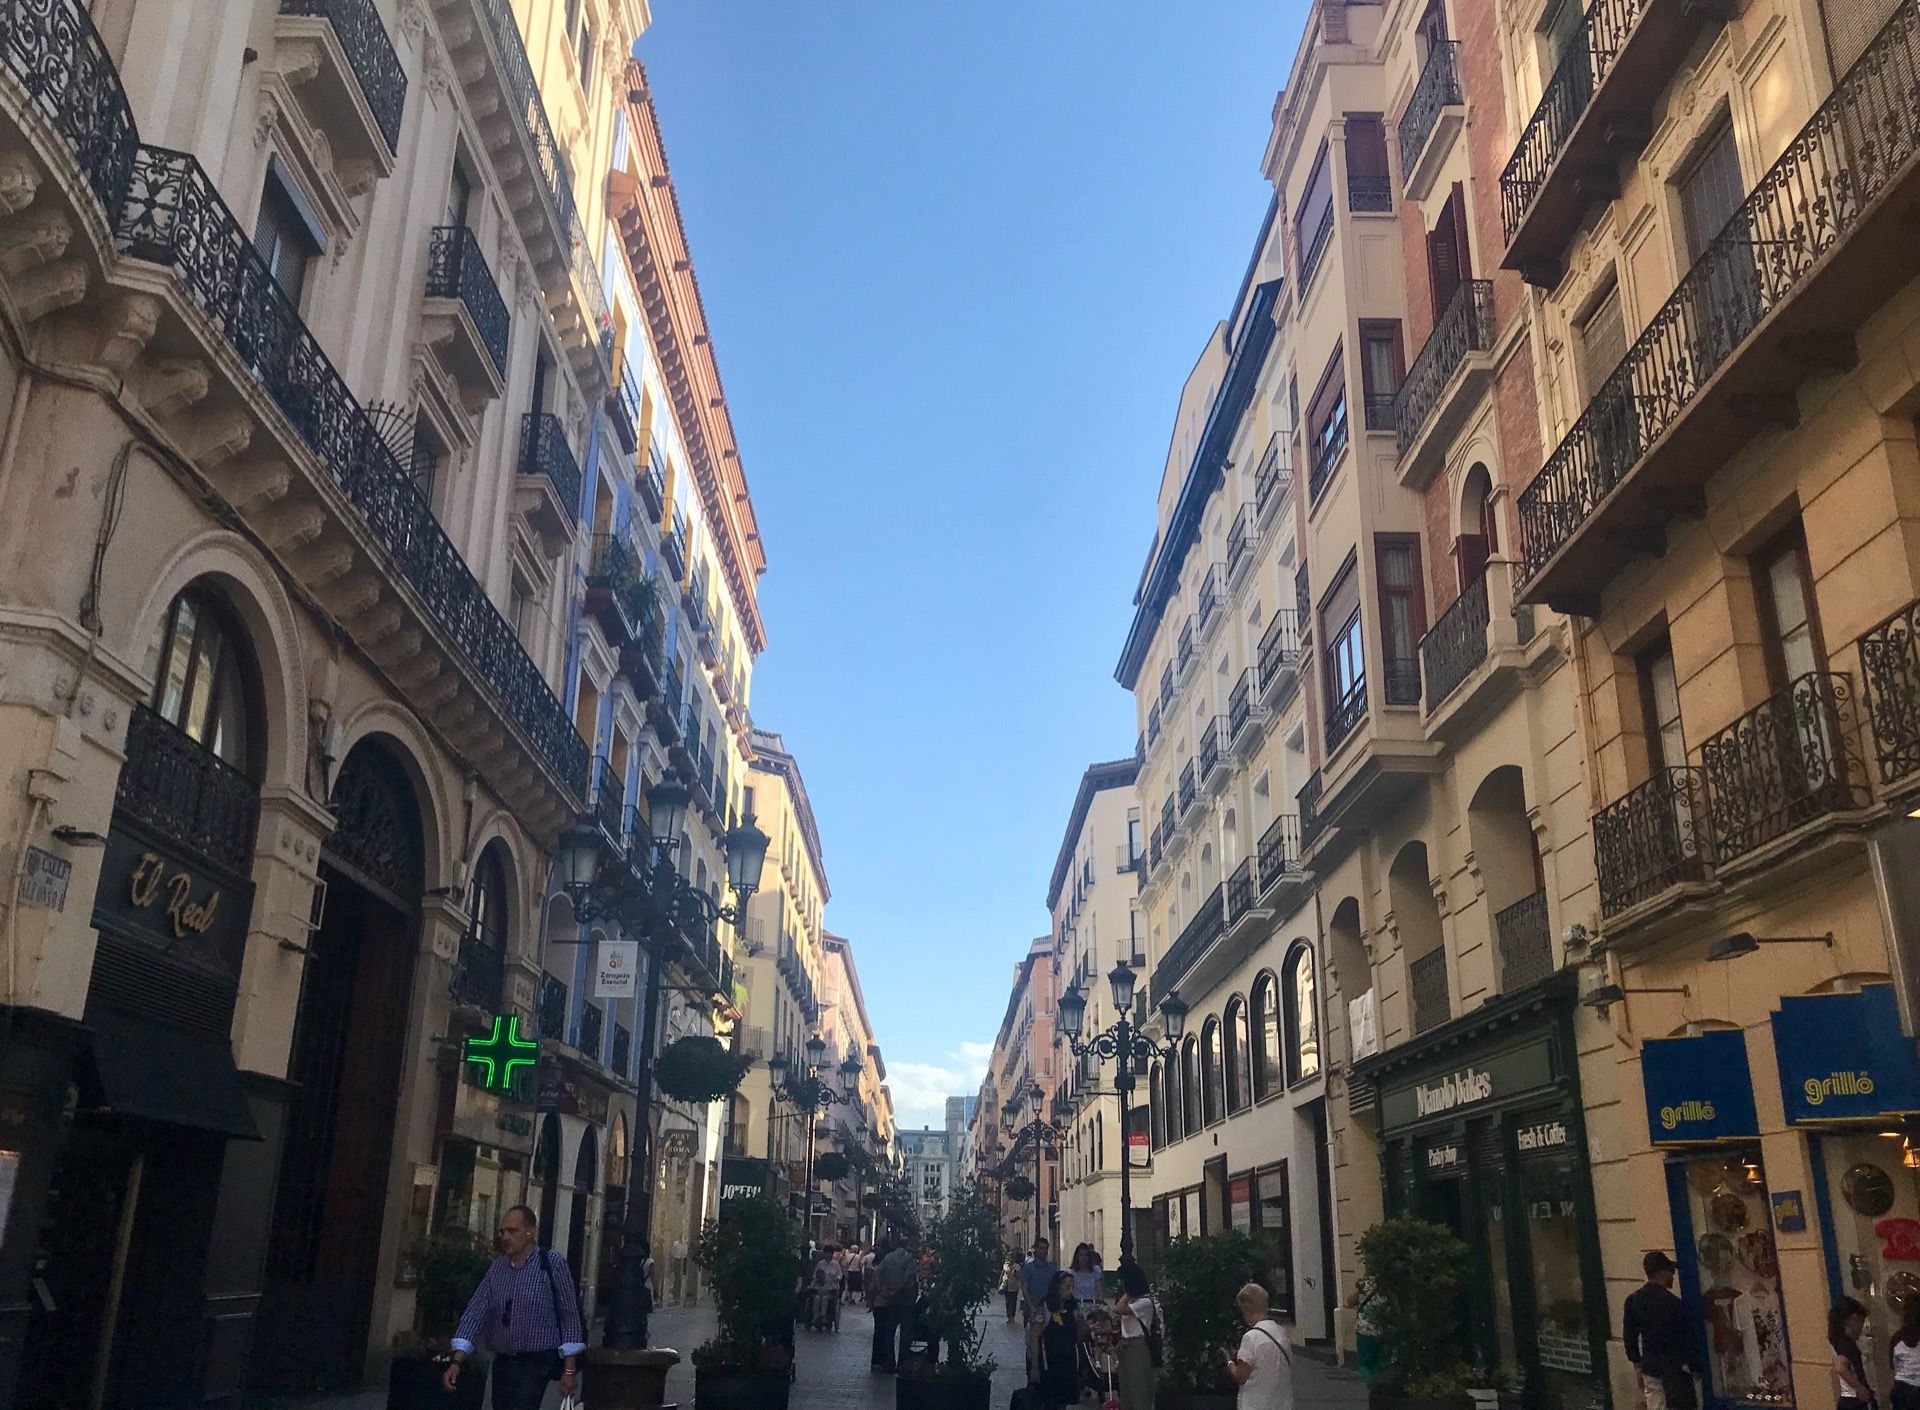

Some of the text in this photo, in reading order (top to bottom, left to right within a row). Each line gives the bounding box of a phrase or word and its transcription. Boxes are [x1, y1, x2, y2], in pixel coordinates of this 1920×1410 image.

[132, 853, 220, 938] El Real
[601, 971, 631, 979] Zaragoza
[1415, 1077, 1455, 1118] Manolo
[1517, 1121, 1568, 1151] Fresh & Coffee
[1444, 1145, 1457, 1166] shop
